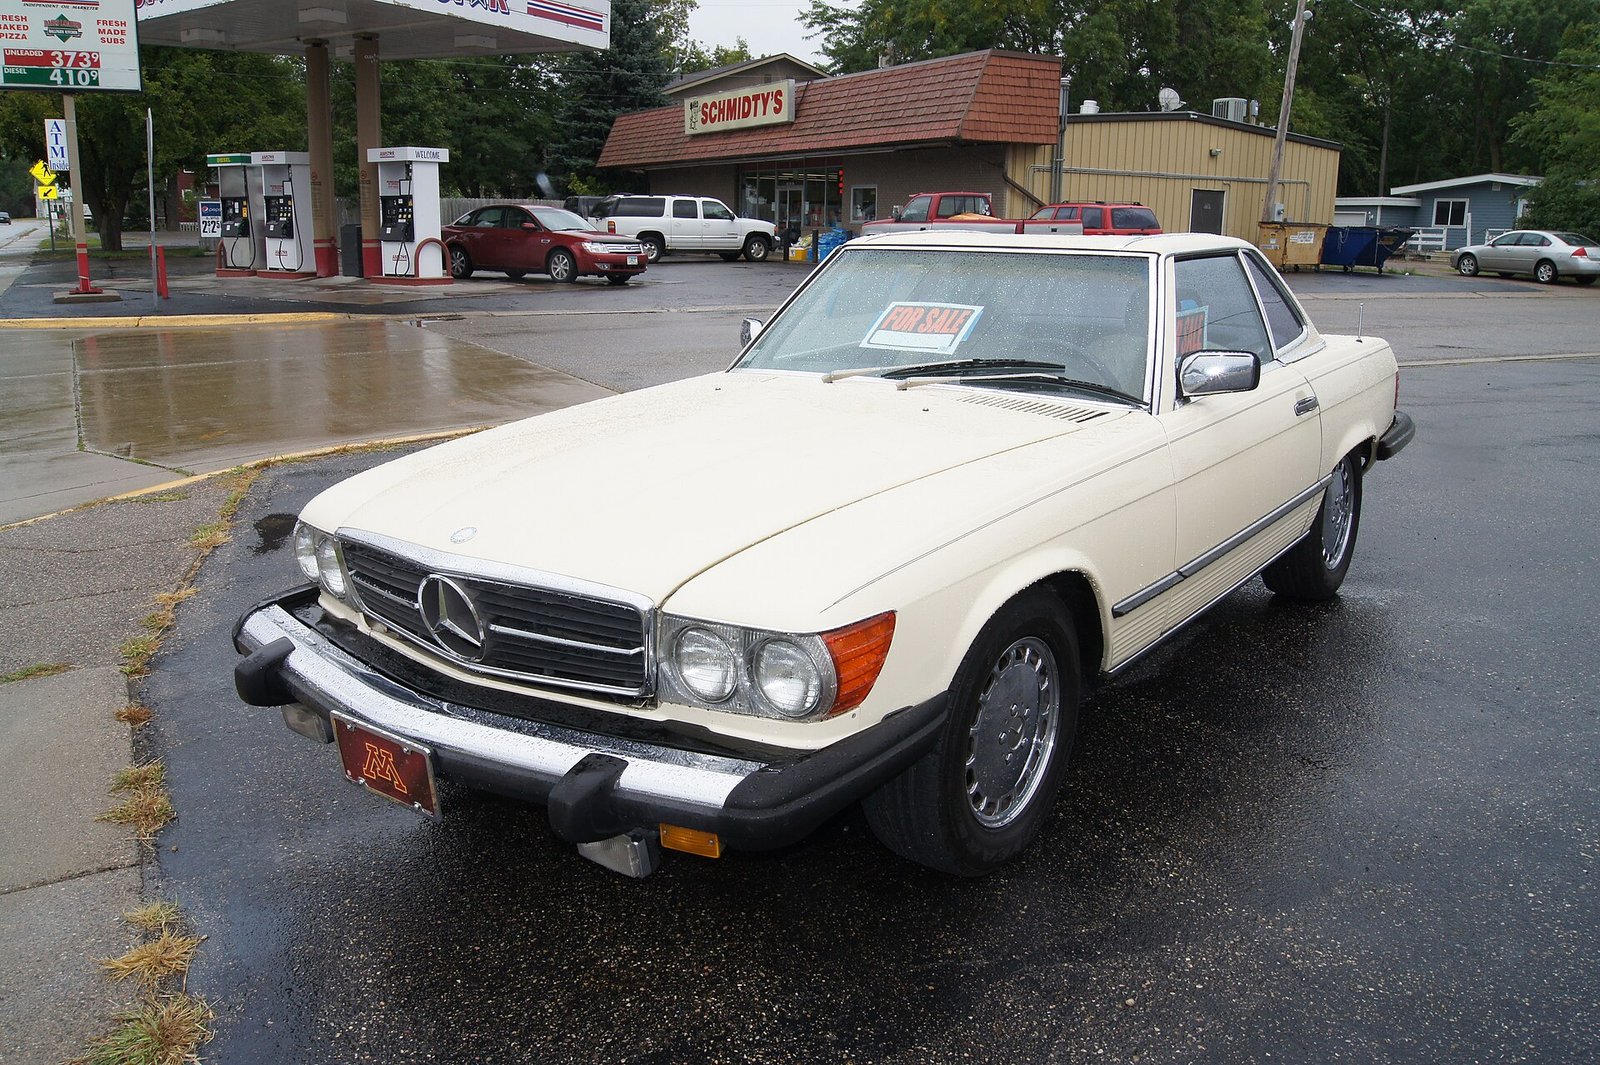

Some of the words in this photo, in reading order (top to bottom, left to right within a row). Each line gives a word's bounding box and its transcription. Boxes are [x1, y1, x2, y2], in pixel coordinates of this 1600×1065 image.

[0, 14, 28, 22] RESH
[96, 19, 127, 27] FRESH
[0, 32, 28, 40] PIZZA
[98, 28, 127, 36] MADE
[5, 49, 44, 57] UNLEADED
[700, 89, 783, 125] SCHMIDTY'S
[50, 121, 66, 158] ATM
[414, 150, 441, 159] WELCOME
[49, 160, 70, 171] Inside
[881, 306, 925, 331] FOR
[918, 308, 972, 333] SALE
[362, 742, 408, 794] M
